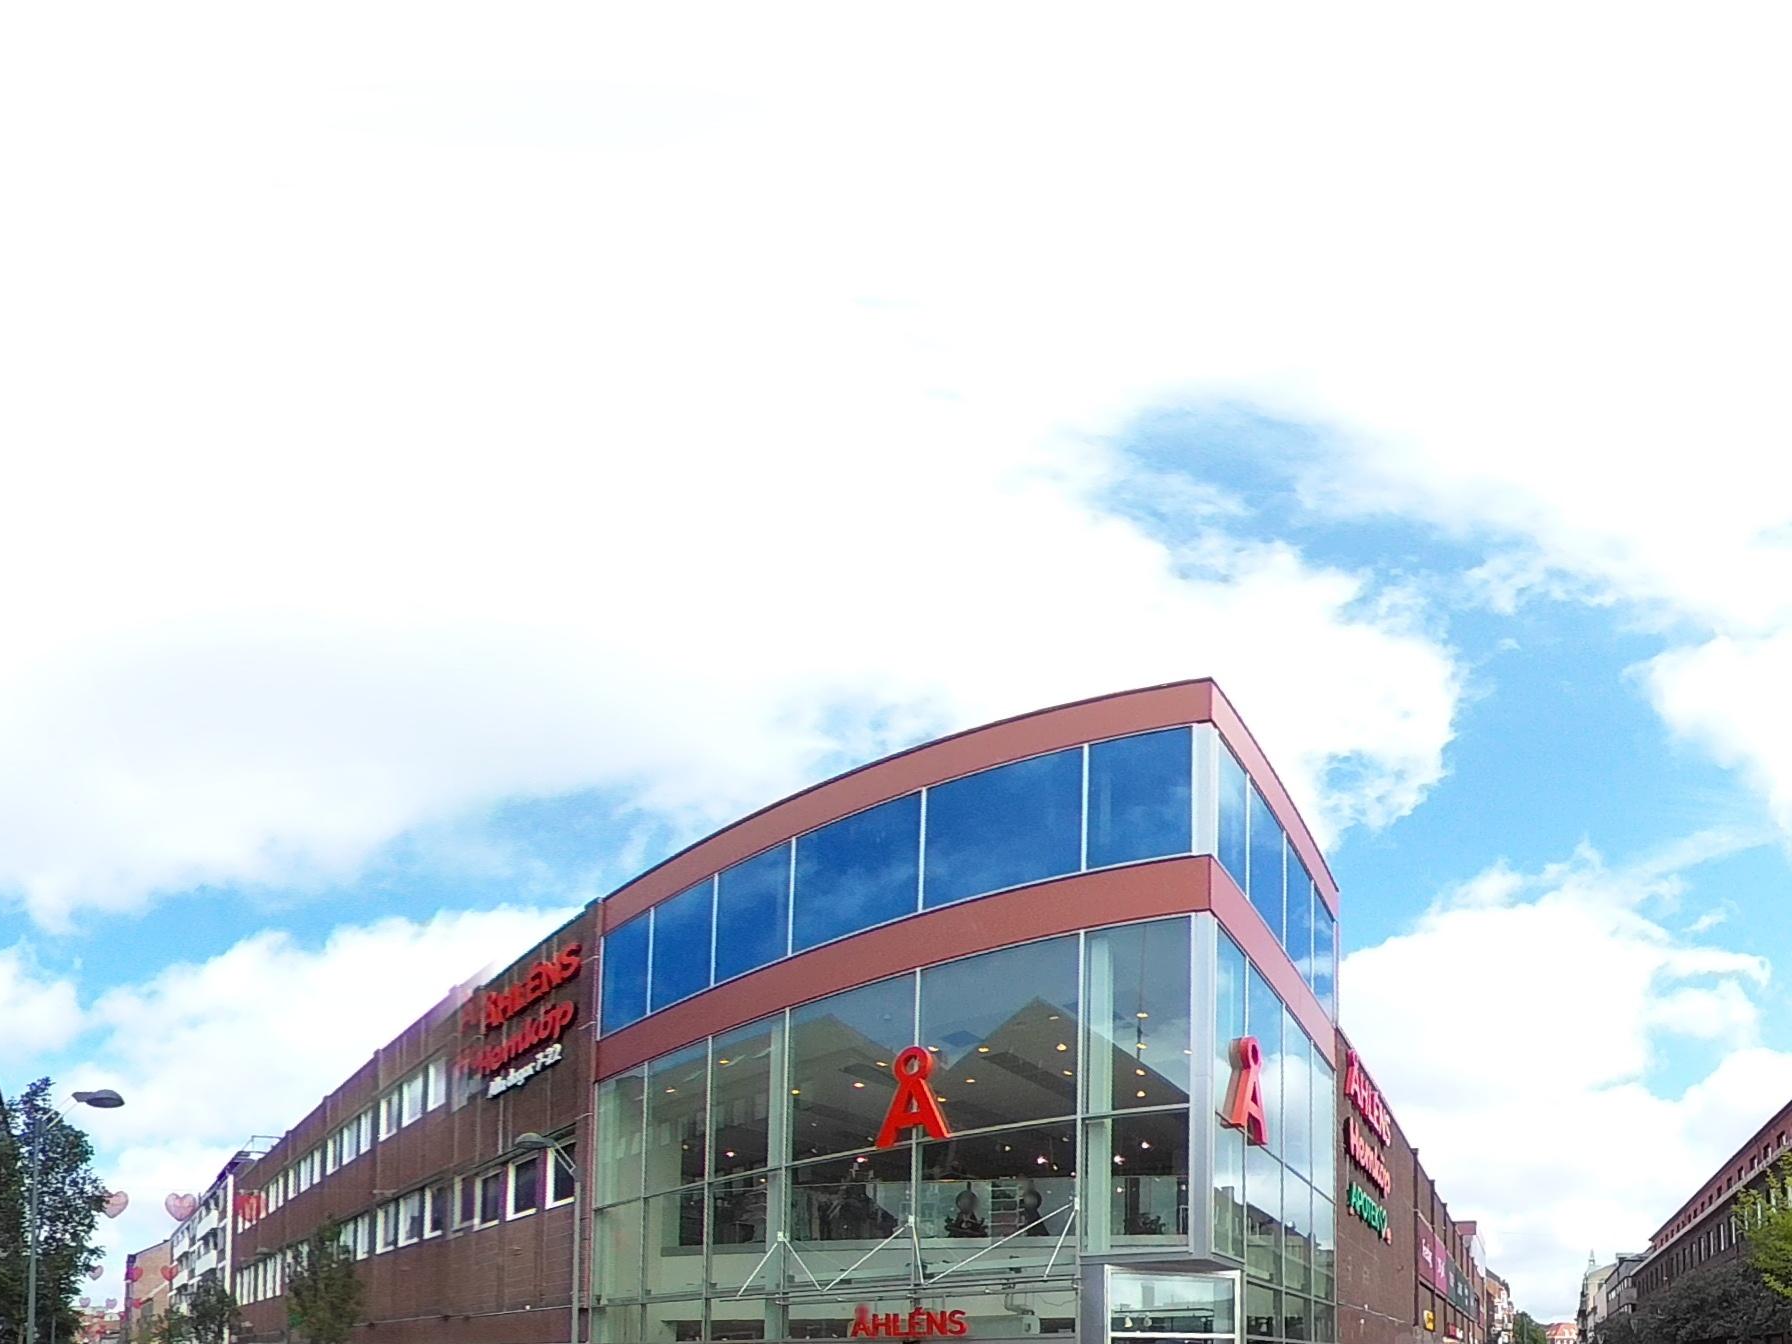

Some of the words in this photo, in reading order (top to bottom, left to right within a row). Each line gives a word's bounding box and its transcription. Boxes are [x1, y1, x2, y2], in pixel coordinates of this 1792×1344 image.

[875, 1046, 950, 1149] Å
[1228, 1036, 1268, 1146] Å
[1348, 1116, 1391, 1200] Hemköp
[850, 1303, 969, 1338] ÅHLÉNS
